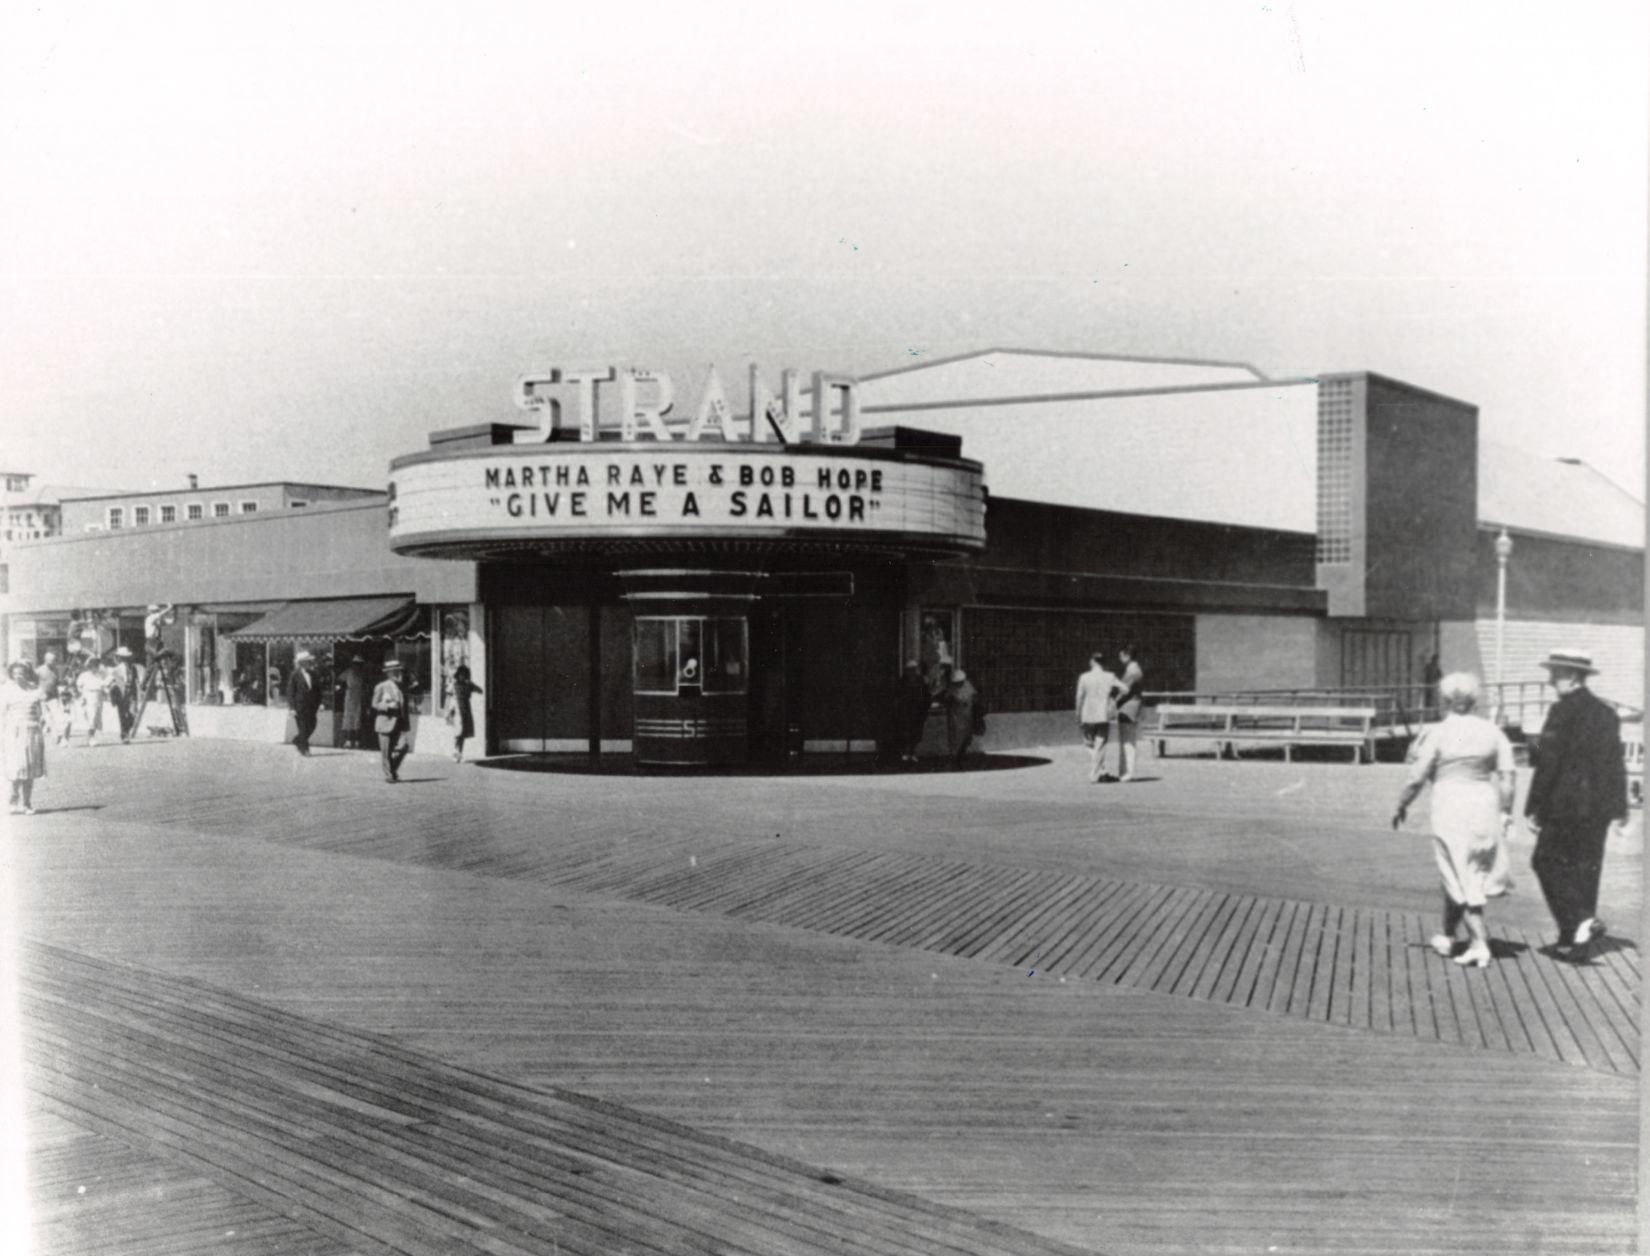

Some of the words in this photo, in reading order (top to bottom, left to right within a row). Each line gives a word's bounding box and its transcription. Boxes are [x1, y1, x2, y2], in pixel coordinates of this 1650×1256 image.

[512, 364, 862, 446] STRAND
[485, 465, 590, 488] MARTHA
[607, 464, 687, 486] RAYE
[708, 464, 724, 485] &
[739, 464, 795, 488] BOB
[817, 467, 883, 493] HOPE
[490, 492, 587, 518] "GIVE
[607, 491, 657, 517] ME
[681, 491, 700, 517] A
[729, 490, 881, 522] SAILOR"
